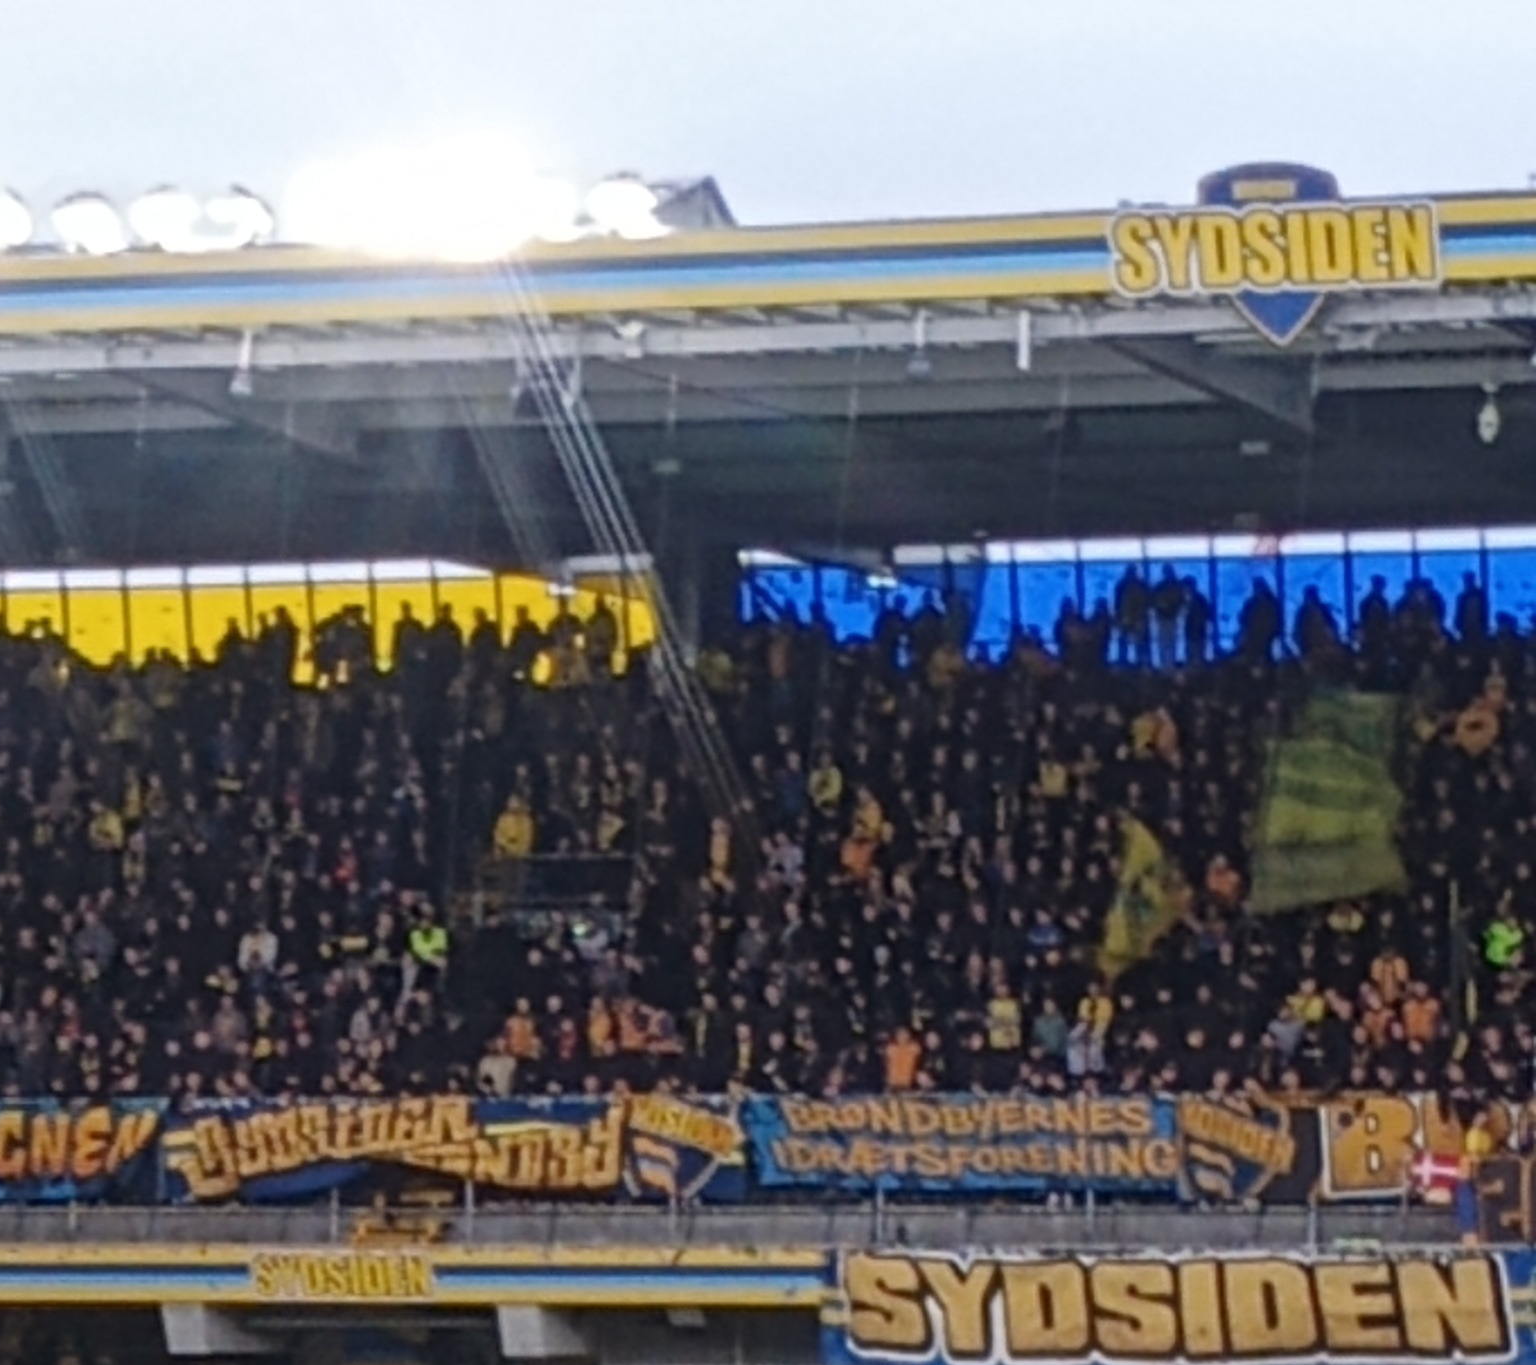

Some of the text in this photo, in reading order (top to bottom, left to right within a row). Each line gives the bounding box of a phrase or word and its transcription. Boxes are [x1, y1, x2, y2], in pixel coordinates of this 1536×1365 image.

[1114, 205, 1434, 291] SYDSIDEN
[784, 1097, 1152, 1140] BRØNDBYERNES
[772, 1137, 1178, 1178] IDRÆTSFORENING
[254, 1252, 430, 1297] SYDSIDEN
[846, 1253, 1502, 1356] SYDSIDEN
